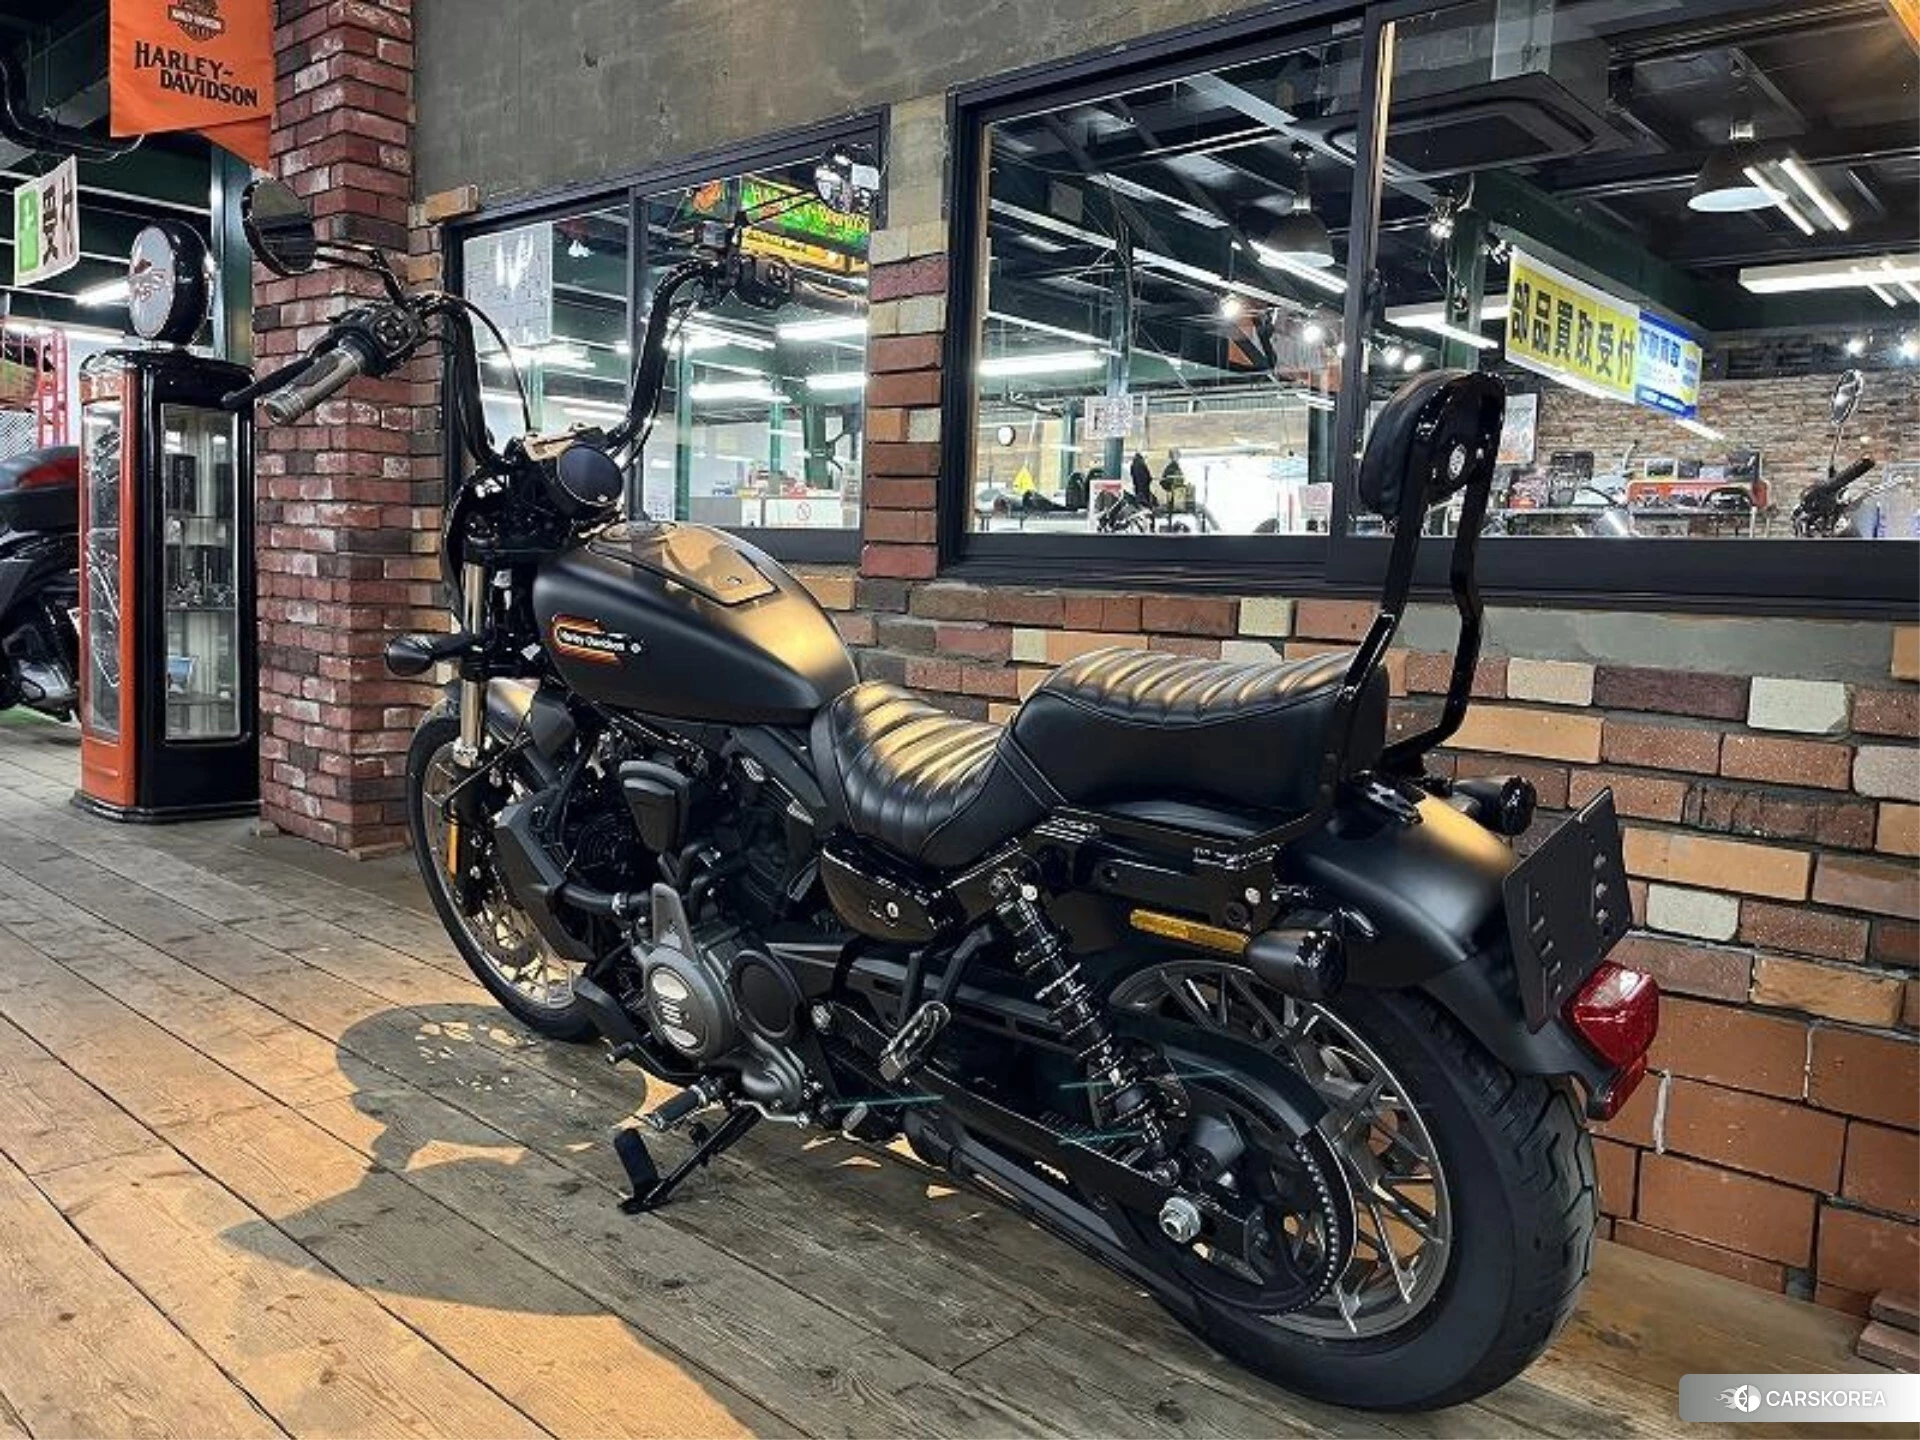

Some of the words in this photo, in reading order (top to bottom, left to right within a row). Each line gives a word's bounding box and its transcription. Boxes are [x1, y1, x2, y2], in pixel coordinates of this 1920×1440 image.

[160, 70, 258, 108] DAVIDSON
[1511, 278, 1635, 385] 部品買取受付
